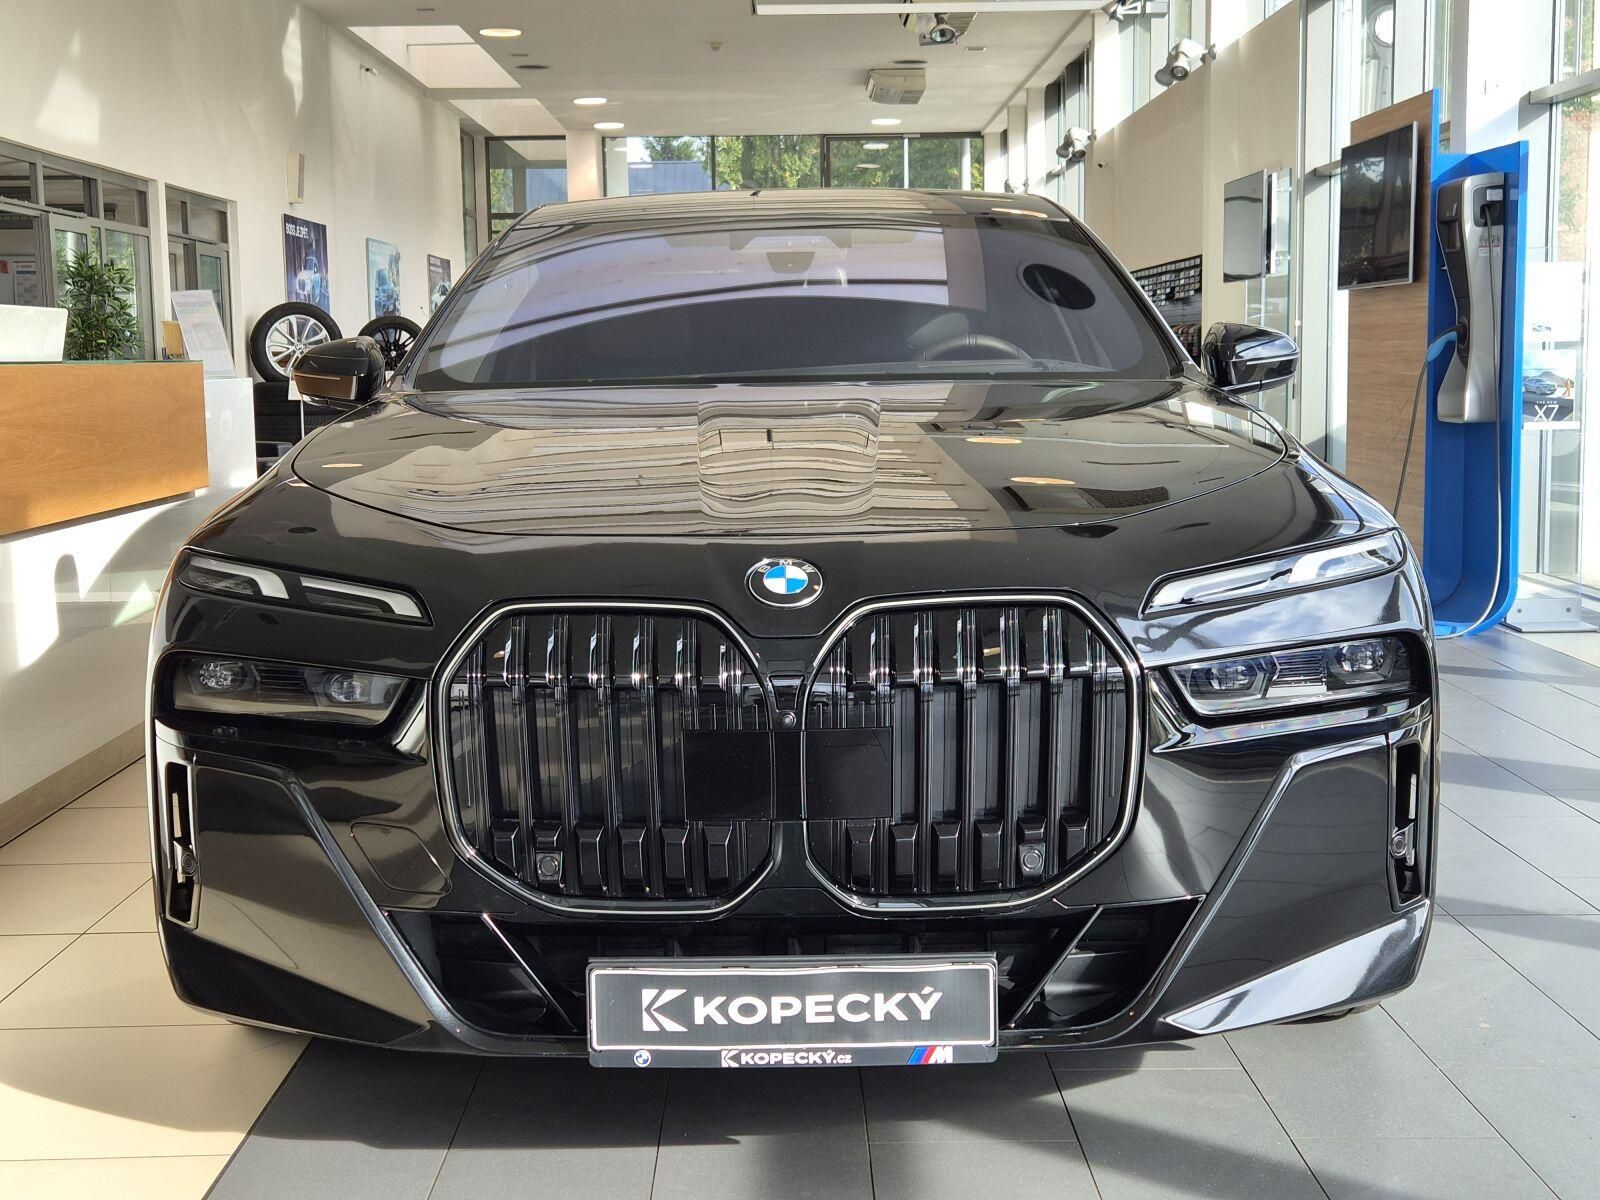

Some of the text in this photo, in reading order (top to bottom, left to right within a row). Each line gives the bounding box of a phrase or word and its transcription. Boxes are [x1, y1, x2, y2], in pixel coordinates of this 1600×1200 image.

[1534, 404, 1559, 421] X7
[757, 559, 816, 573] BMW
[693, 986, 943, 1025] KOPECKÝ
[740, 1049, 853, 1065] KOPECKÝ.cz
[928, 1045, 954, 1065] M
